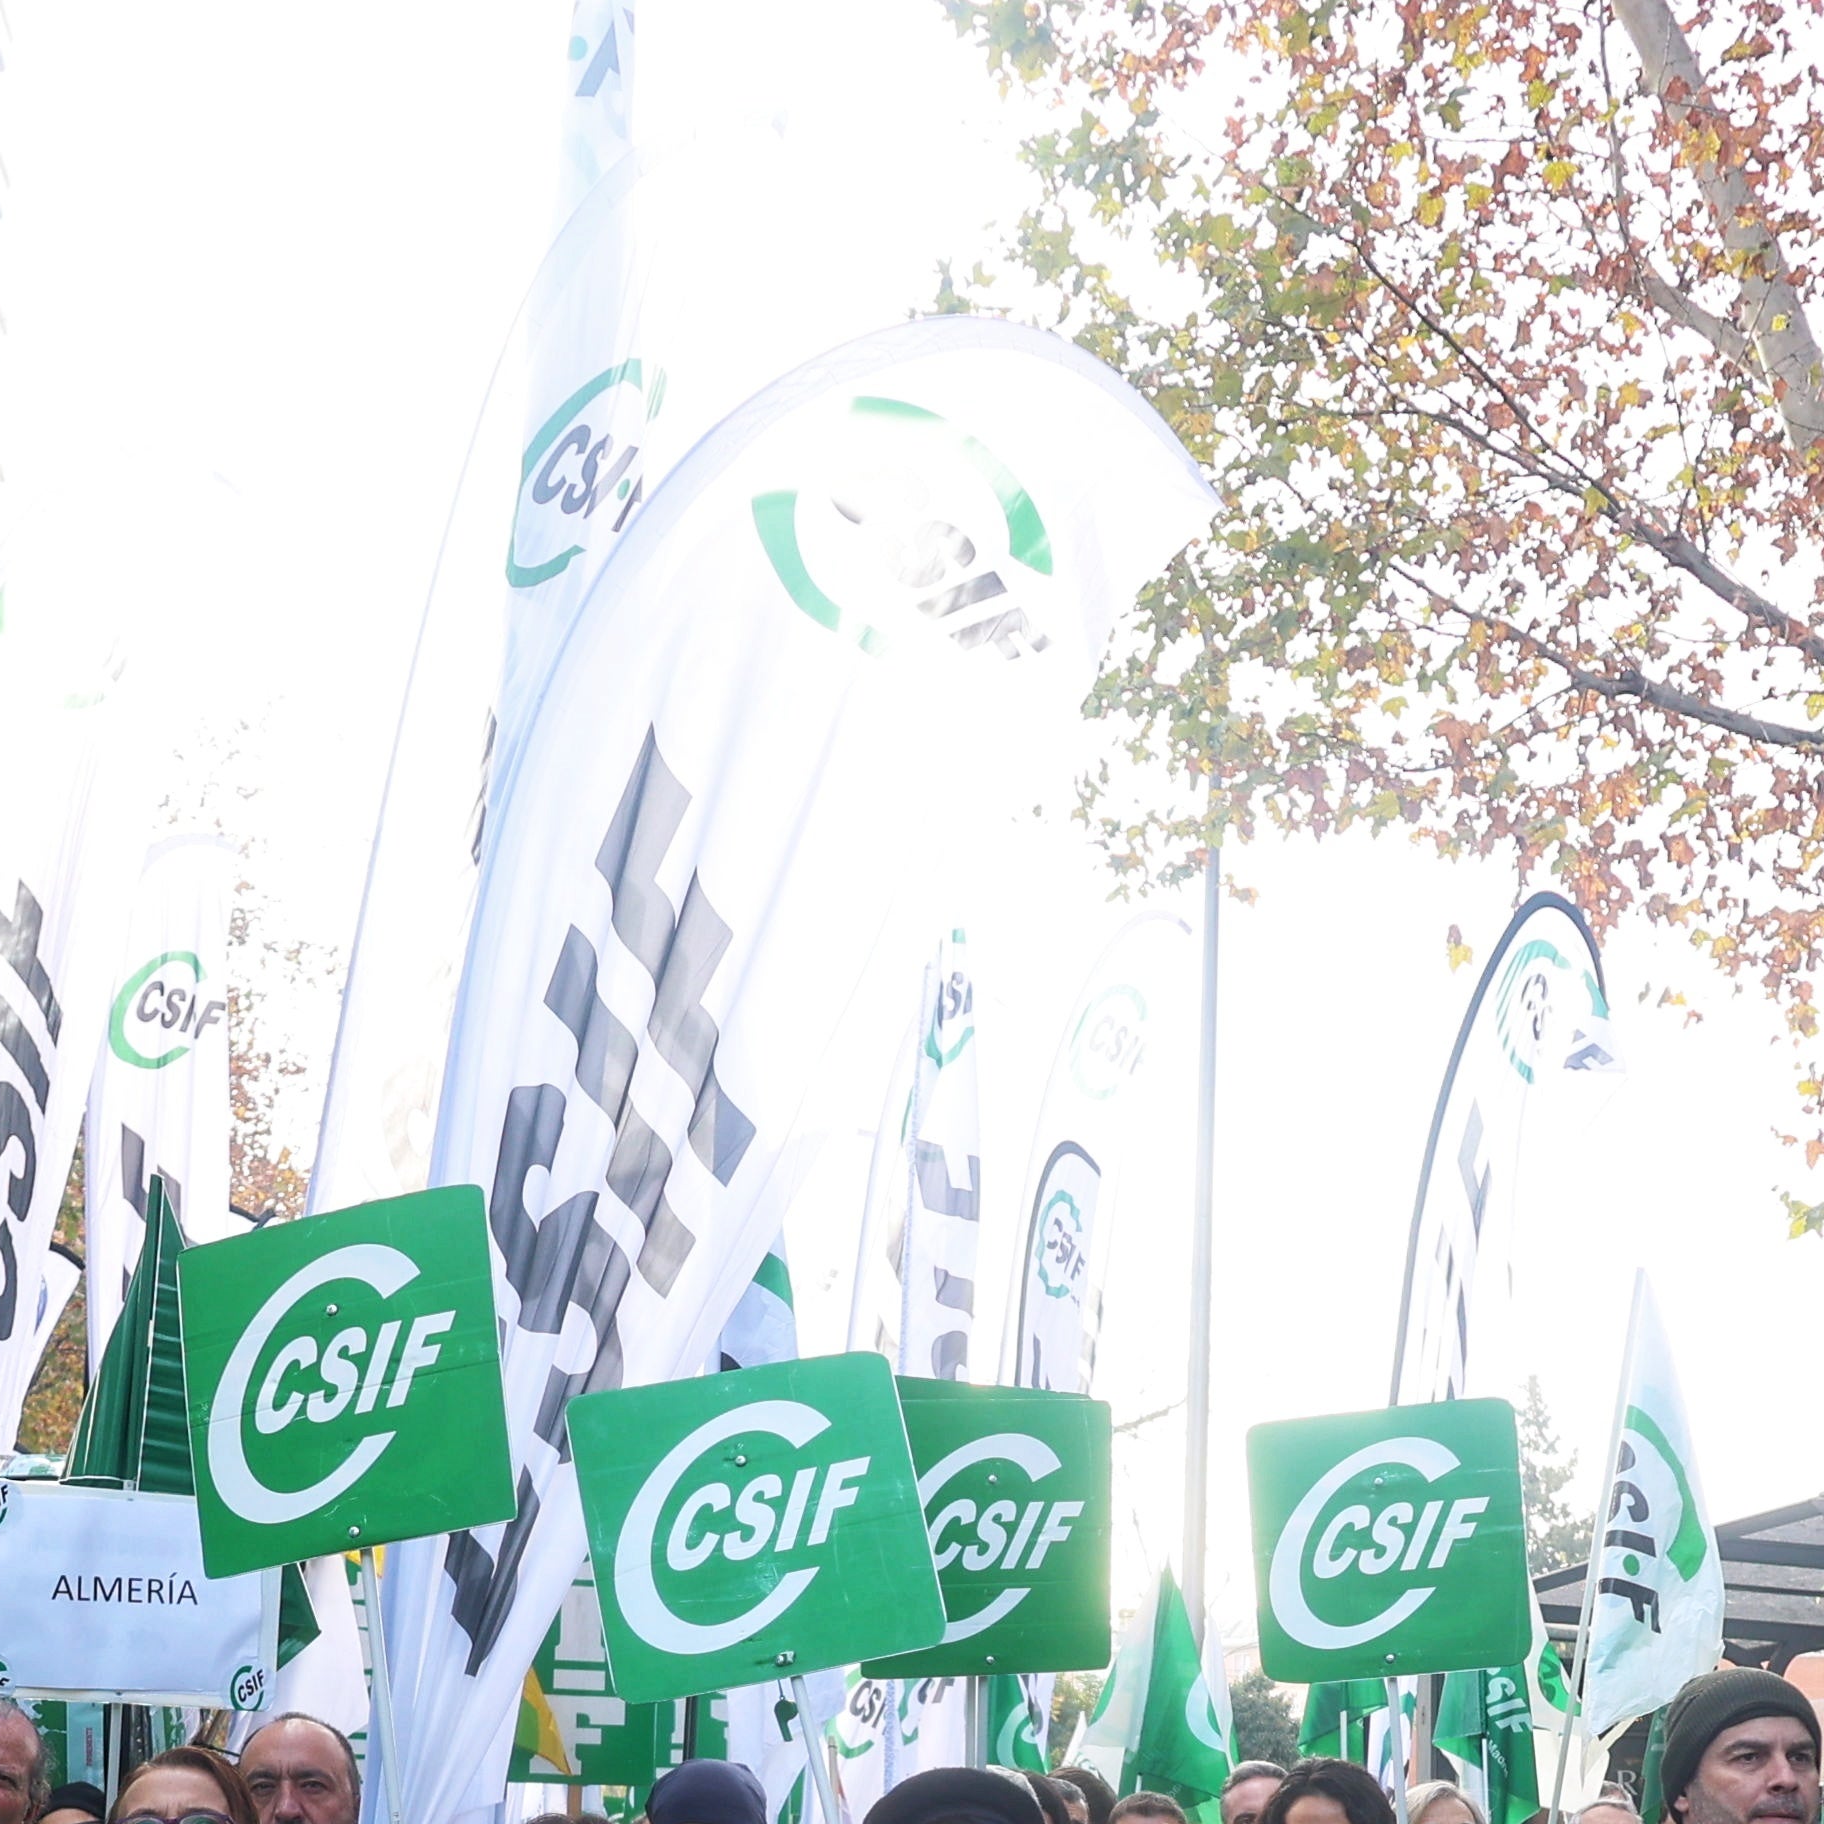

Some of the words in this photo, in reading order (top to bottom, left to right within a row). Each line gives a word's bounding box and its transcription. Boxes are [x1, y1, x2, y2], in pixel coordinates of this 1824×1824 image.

[253, 1309, 458, 1435] CSIF
[665, 1455, 872, 1572] CSIF
[929, 1500, 1086, 1572] CSIF
[1311, 1495, 1491, 1580] CSIF
[51, 1570, 199, 1606] ALMERÍA
[235, 1667, 264, 1704] CSIF
[1485, 1667, 1535, 1737] SIF
